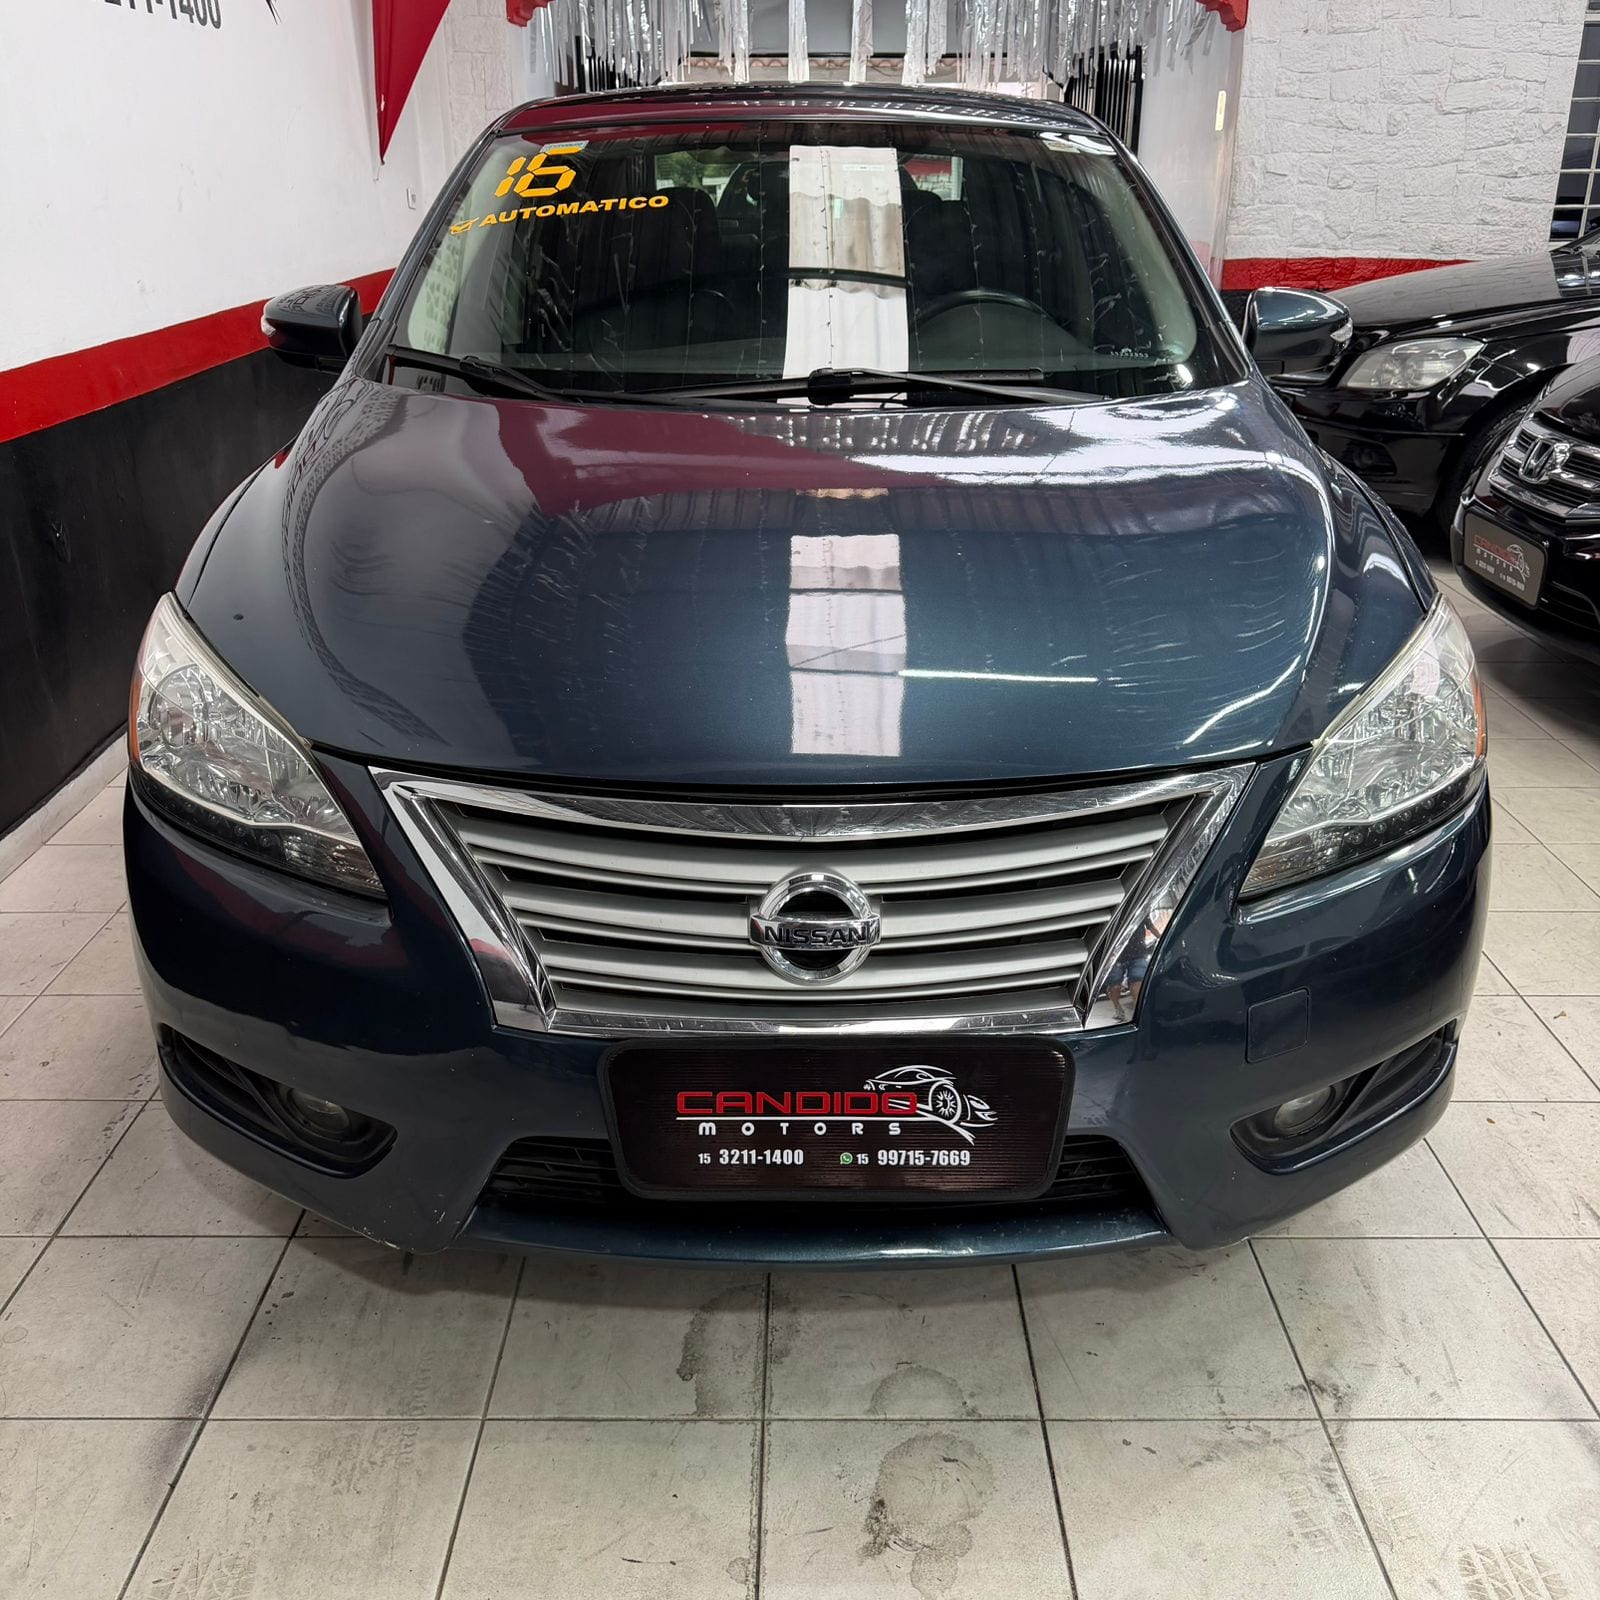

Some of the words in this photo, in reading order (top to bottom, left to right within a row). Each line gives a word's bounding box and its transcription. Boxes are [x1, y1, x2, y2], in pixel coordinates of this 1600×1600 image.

[105, 0, 221, 29] -1400
[495, 147, 582, 198] 16
[480, 195, 669, 227] AUTOMATICO
[764, 925, 867, 944] NISSAN
[676, 1091, 917, 1115] CANDIDO
[698, 1122, 901, 1136] MOTORS
[698, 1153, 711, 1165] 15
[719, 1149, 804, 1165] 3211-1400
[856, 1153, 869, 1165] 15
[877, 1149, 971, 1166] 99715-7669
